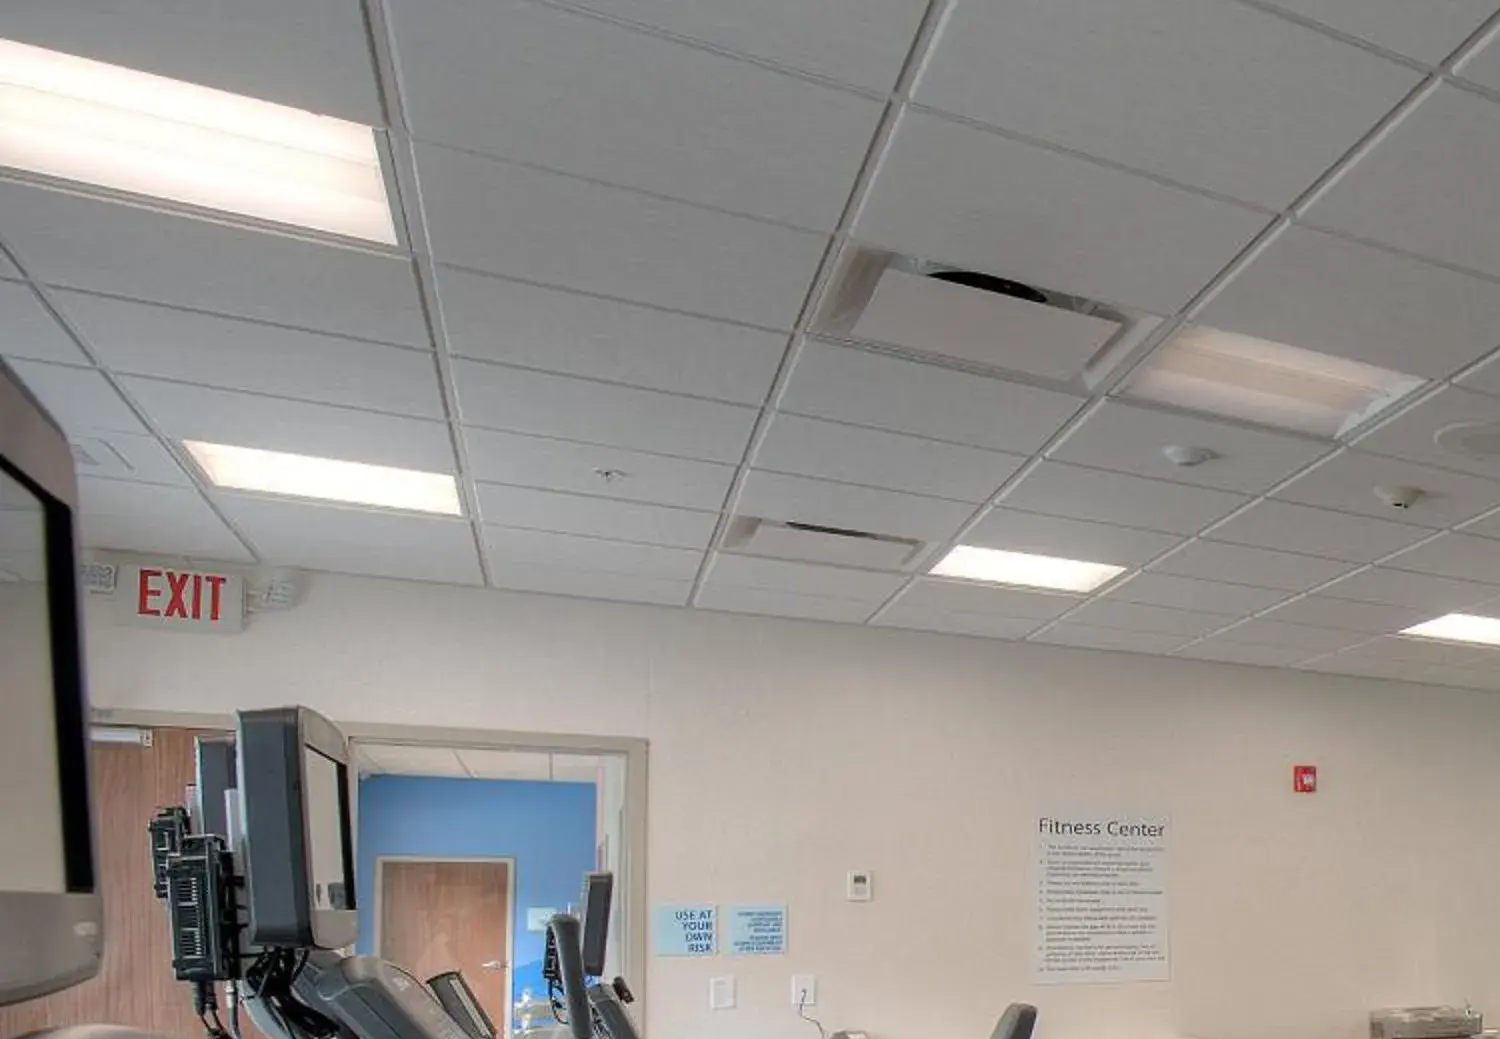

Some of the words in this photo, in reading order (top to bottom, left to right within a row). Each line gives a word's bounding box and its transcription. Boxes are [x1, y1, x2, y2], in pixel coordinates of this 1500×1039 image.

[137, 568, 227, 620] EXIT
[1039, 817, 1101, 835] Fitness
[1107, 821, 1165, 837] Center
[674, 910, 697, 921] USE
[699, 909, 713, 921] AT
[681, 920, 713, 931] YOUR
[685, 931, 712, 942] OWN
[687, 943, 712, 953] RISK
